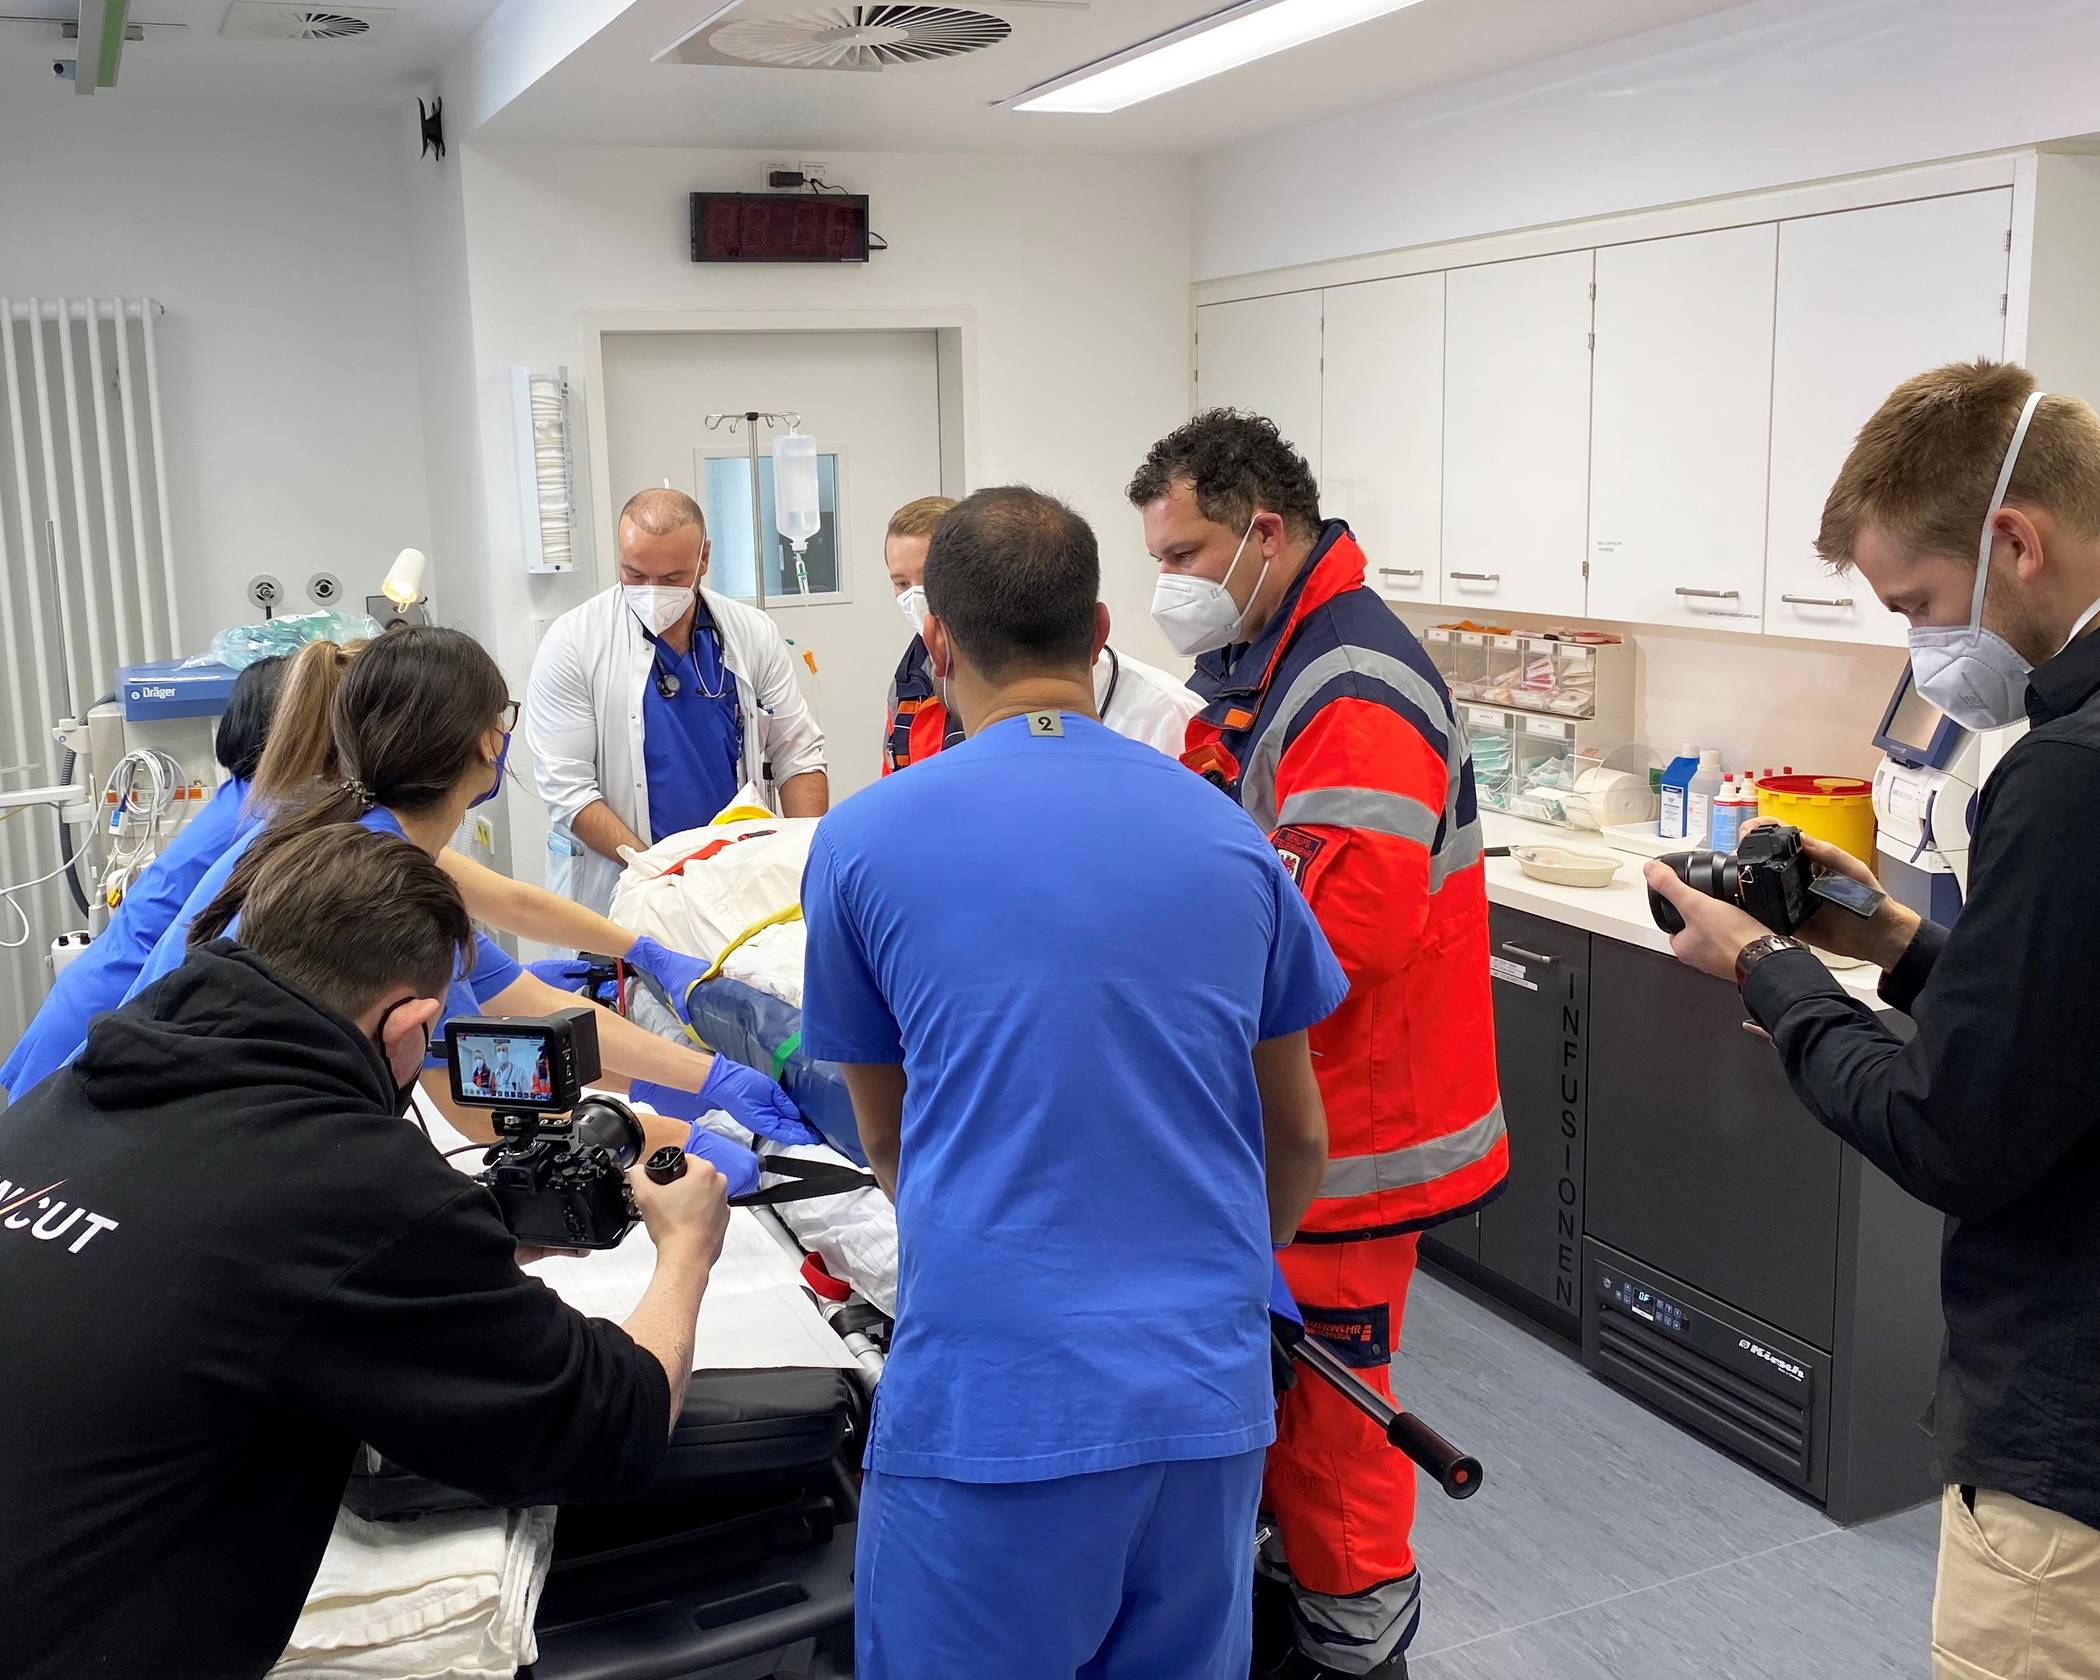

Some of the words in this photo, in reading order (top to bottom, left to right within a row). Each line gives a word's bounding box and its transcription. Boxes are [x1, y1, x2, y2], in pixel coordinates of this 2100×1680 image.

[143, 686, 176, 699] Dräger
[1038, 716, 1053, 731] 2
[1556, 972, 1580, 1307] INFUSIONEN
[1305, 1320, 1361, 1334] EUERWEHR
[1750, 1344, 1805, 1378] Kirsch
